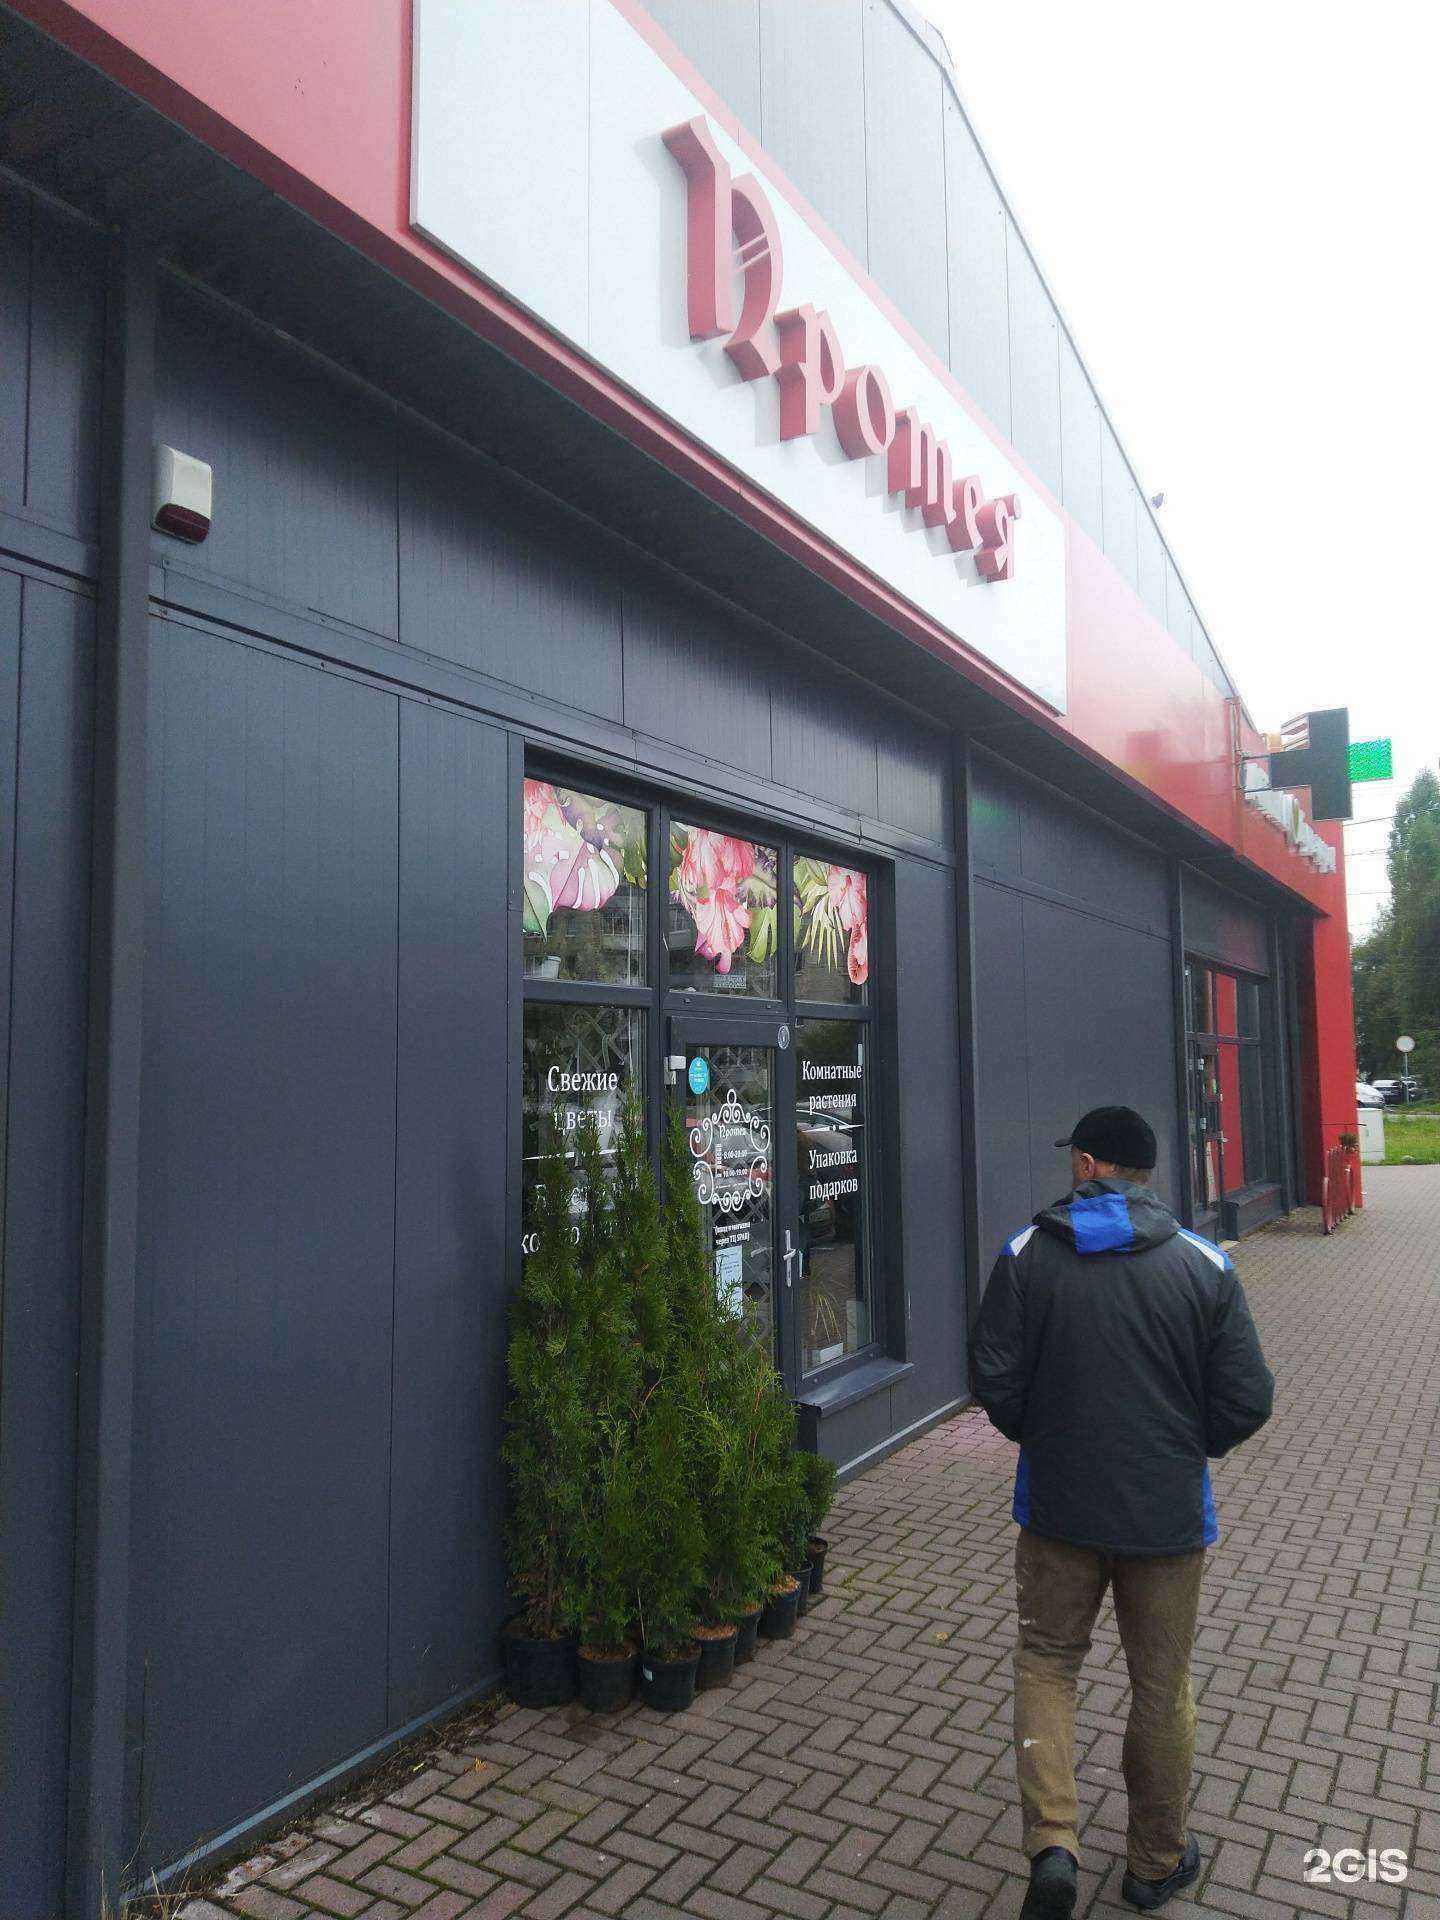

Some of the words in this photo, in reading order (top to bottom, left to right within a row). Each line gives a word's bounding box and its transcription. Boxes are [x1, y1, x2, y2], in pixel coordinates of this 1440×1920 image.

[547, 1065, 619, 1093] Свежие
[801, 1060, 864, 1081] Комнатные
[809, 1093, 857, 1115] растения
[808, 1149, 858, 1170] Упаковка
[809, 1178, 859, 1201] подарков
